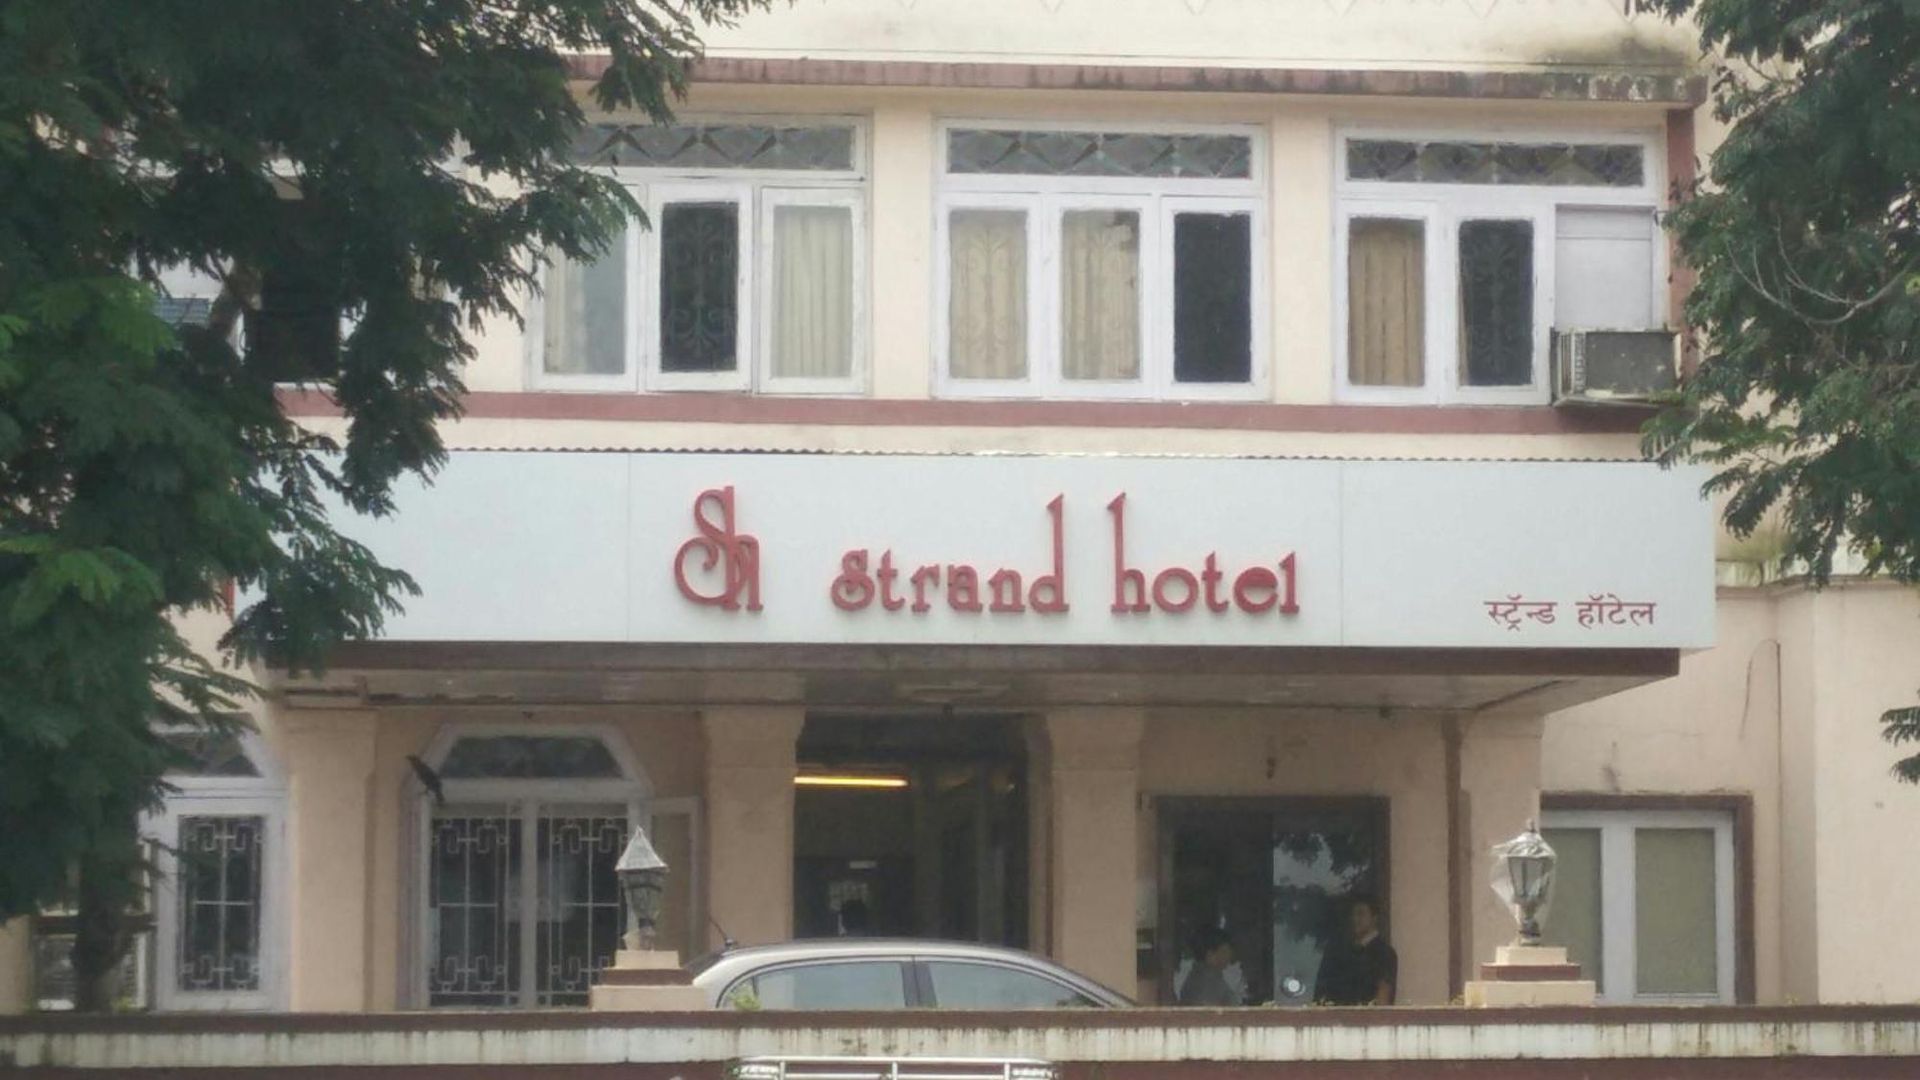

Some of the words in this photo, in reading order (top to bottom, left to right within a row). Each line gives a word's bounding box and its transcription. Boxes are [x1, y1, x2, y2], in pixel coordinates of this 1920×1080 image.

[831, 494, 1069, 613] strand
[1106, 492, 1300, 614] hotel
[1575, 593, 1656, 629] हॉटेल
